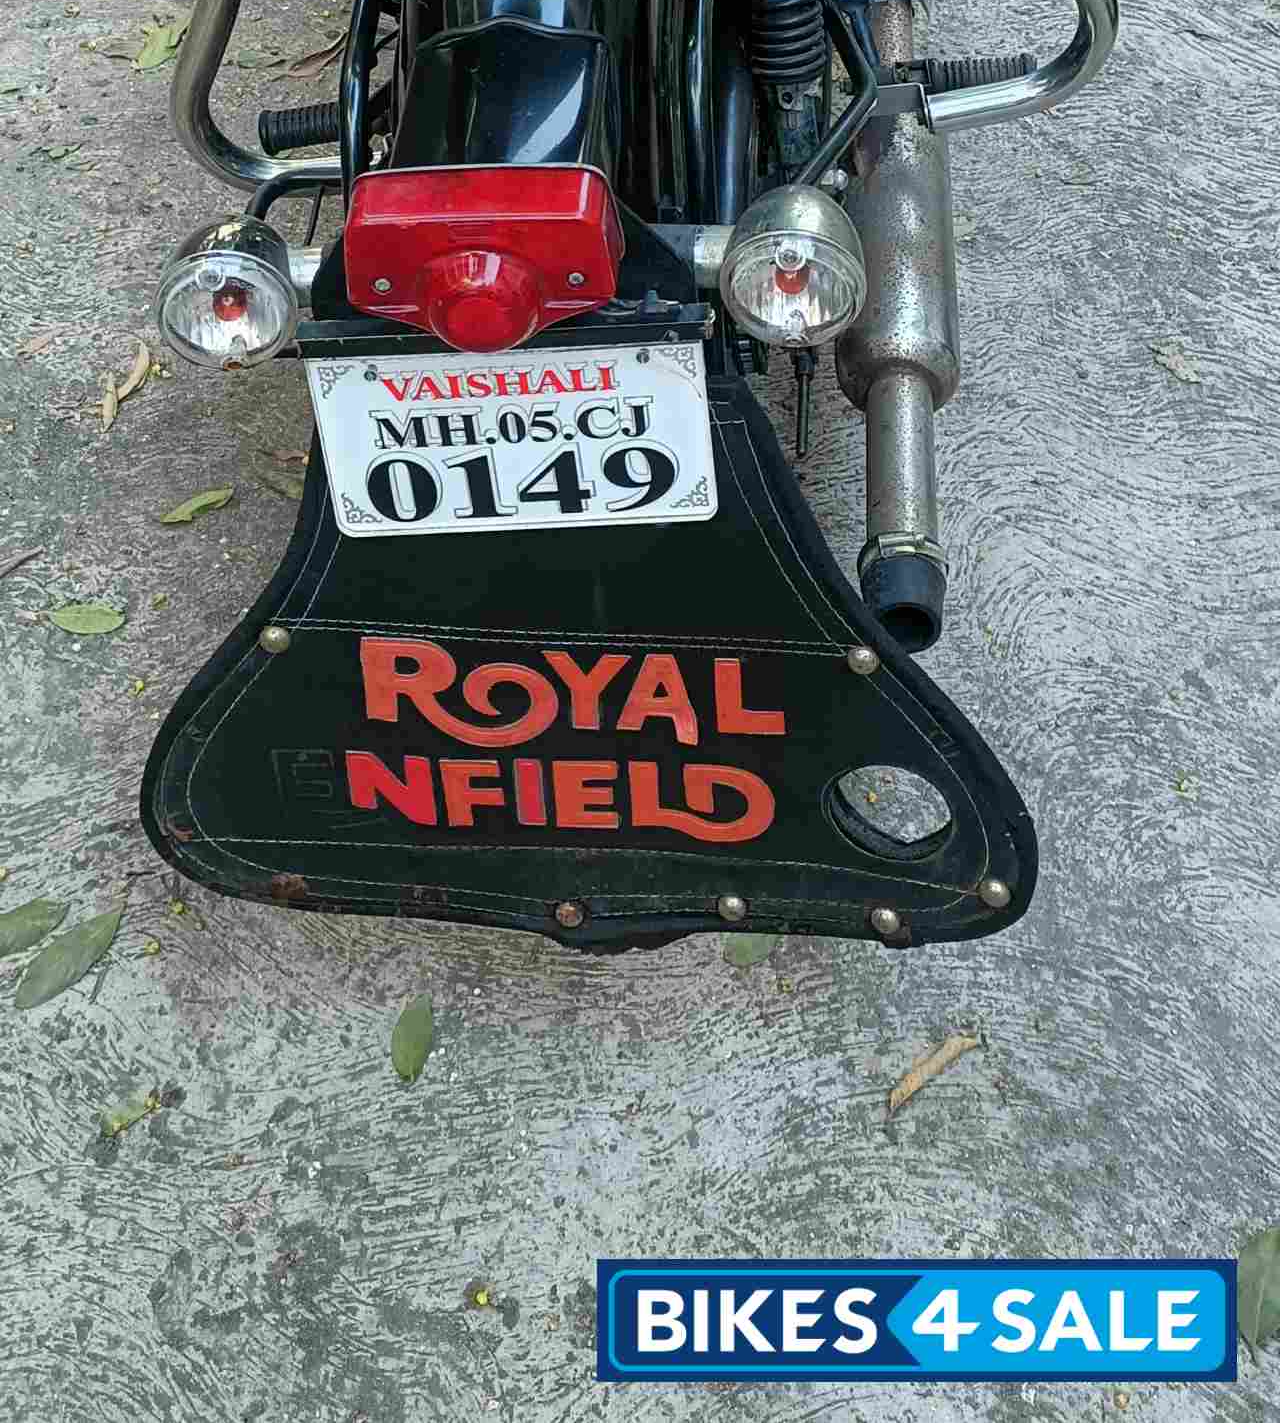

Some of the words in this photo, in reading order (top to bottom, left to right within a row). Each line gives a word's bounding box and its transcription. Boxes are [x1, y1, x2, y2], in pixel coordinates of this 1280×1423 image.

[379, 360, 620, 402] VAISHALI
[369, 395, 655, 449] MH.05.CJ
[365, 440, 680, 523] 0149
[359, 637, 786, 748] ROYAL
